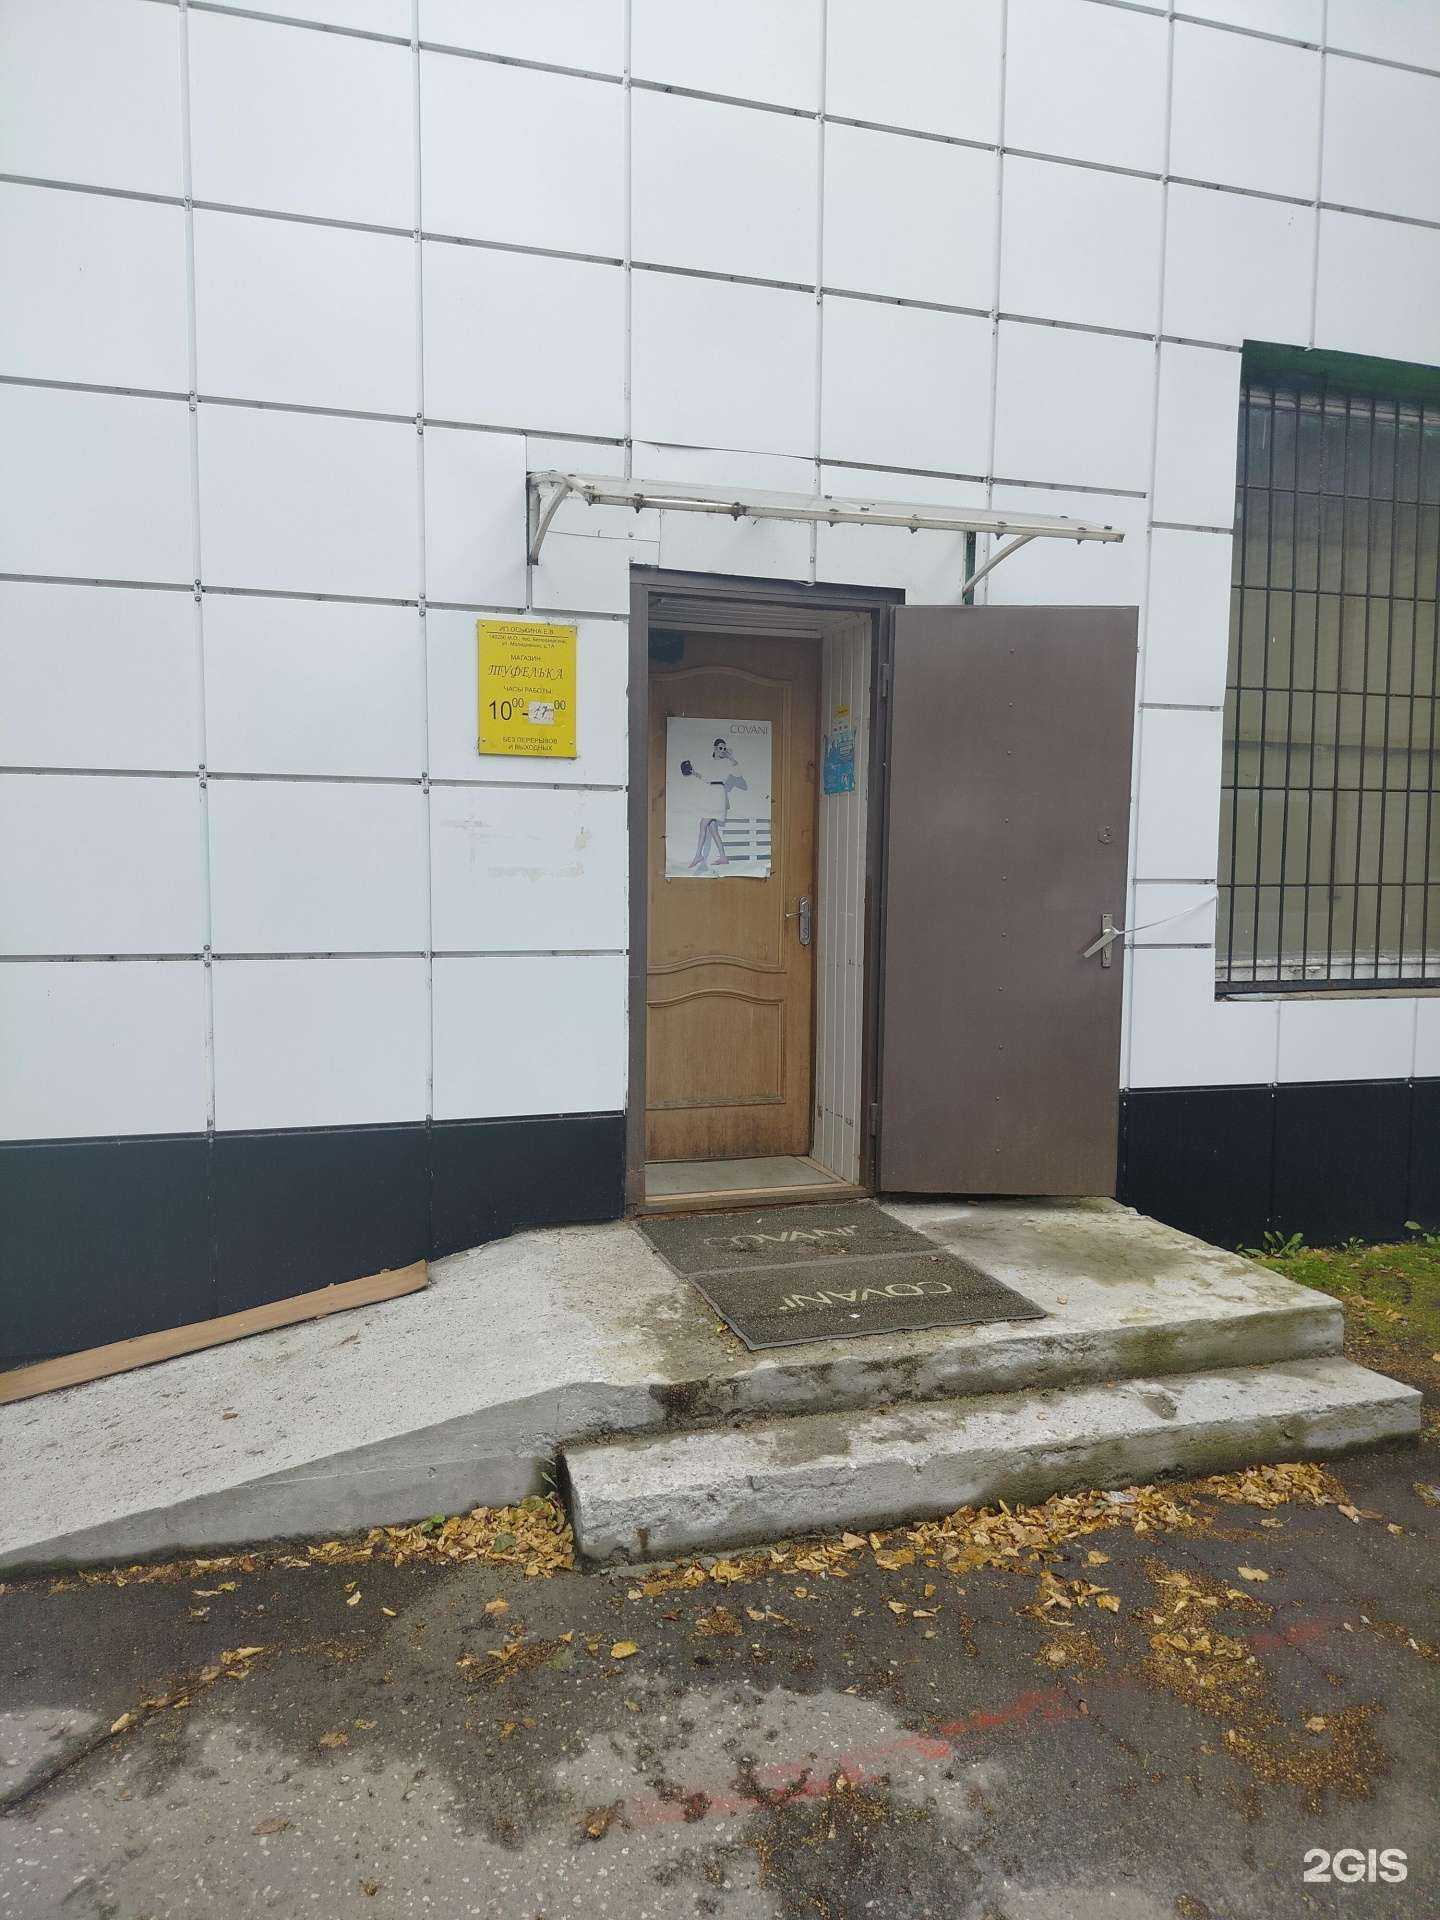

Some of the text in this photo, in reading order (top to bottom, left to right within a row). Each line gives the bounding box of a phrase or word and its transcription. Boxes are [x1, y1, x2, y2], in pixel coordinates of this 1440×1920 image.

[511, 654, 542, 662] МАГАЗИН
[525, 687, 552, 695] РАБОТЫ
[730, 724, 768, 736] COVANI
[517, 737, 558, 745] ПЕРЕРЫВОВ
[704, 1227, 855, 1246] COVANI
[783, 1281, 952, 1307] COVANI
